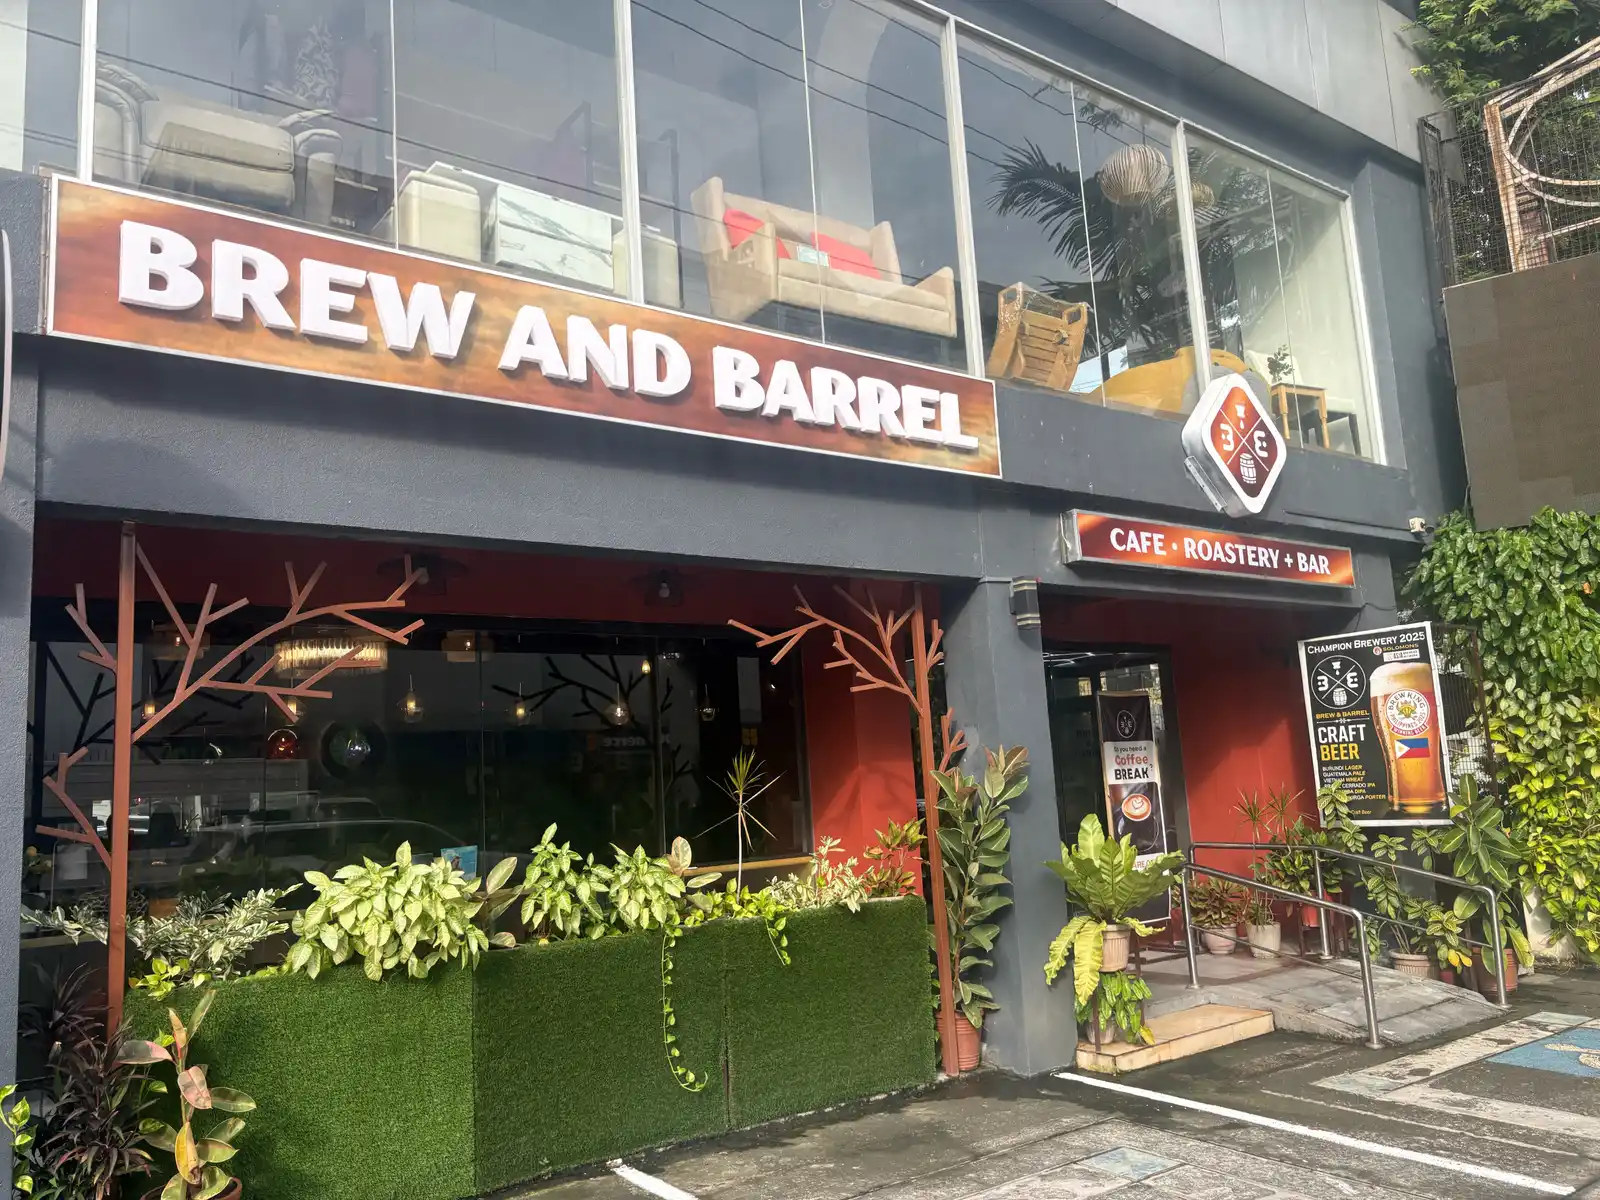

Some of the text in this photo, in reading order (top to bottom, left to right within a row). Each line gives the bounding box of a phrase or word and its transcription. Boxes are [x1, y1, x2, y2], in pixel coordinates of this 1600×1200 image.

[118, 219, 980, 450] BREW AND BARREL
[1109, 527, 1167, 556] CAFE
[1183, 537, 1280, 569] ROASTERY
[1297, 552, 1331, 575] BAR
[1307, 631, 1426, 654] CHAMPION BREWERY 2025
[1387, 691, 1426, 711] BREW KING
[1342, 709, 1370, 717] BARREL
[1317, 724, 1366, 744] CRAFT
[1114, 753, 1149, 766] Coffee
[1320, 743, 1360, 761] BEER
